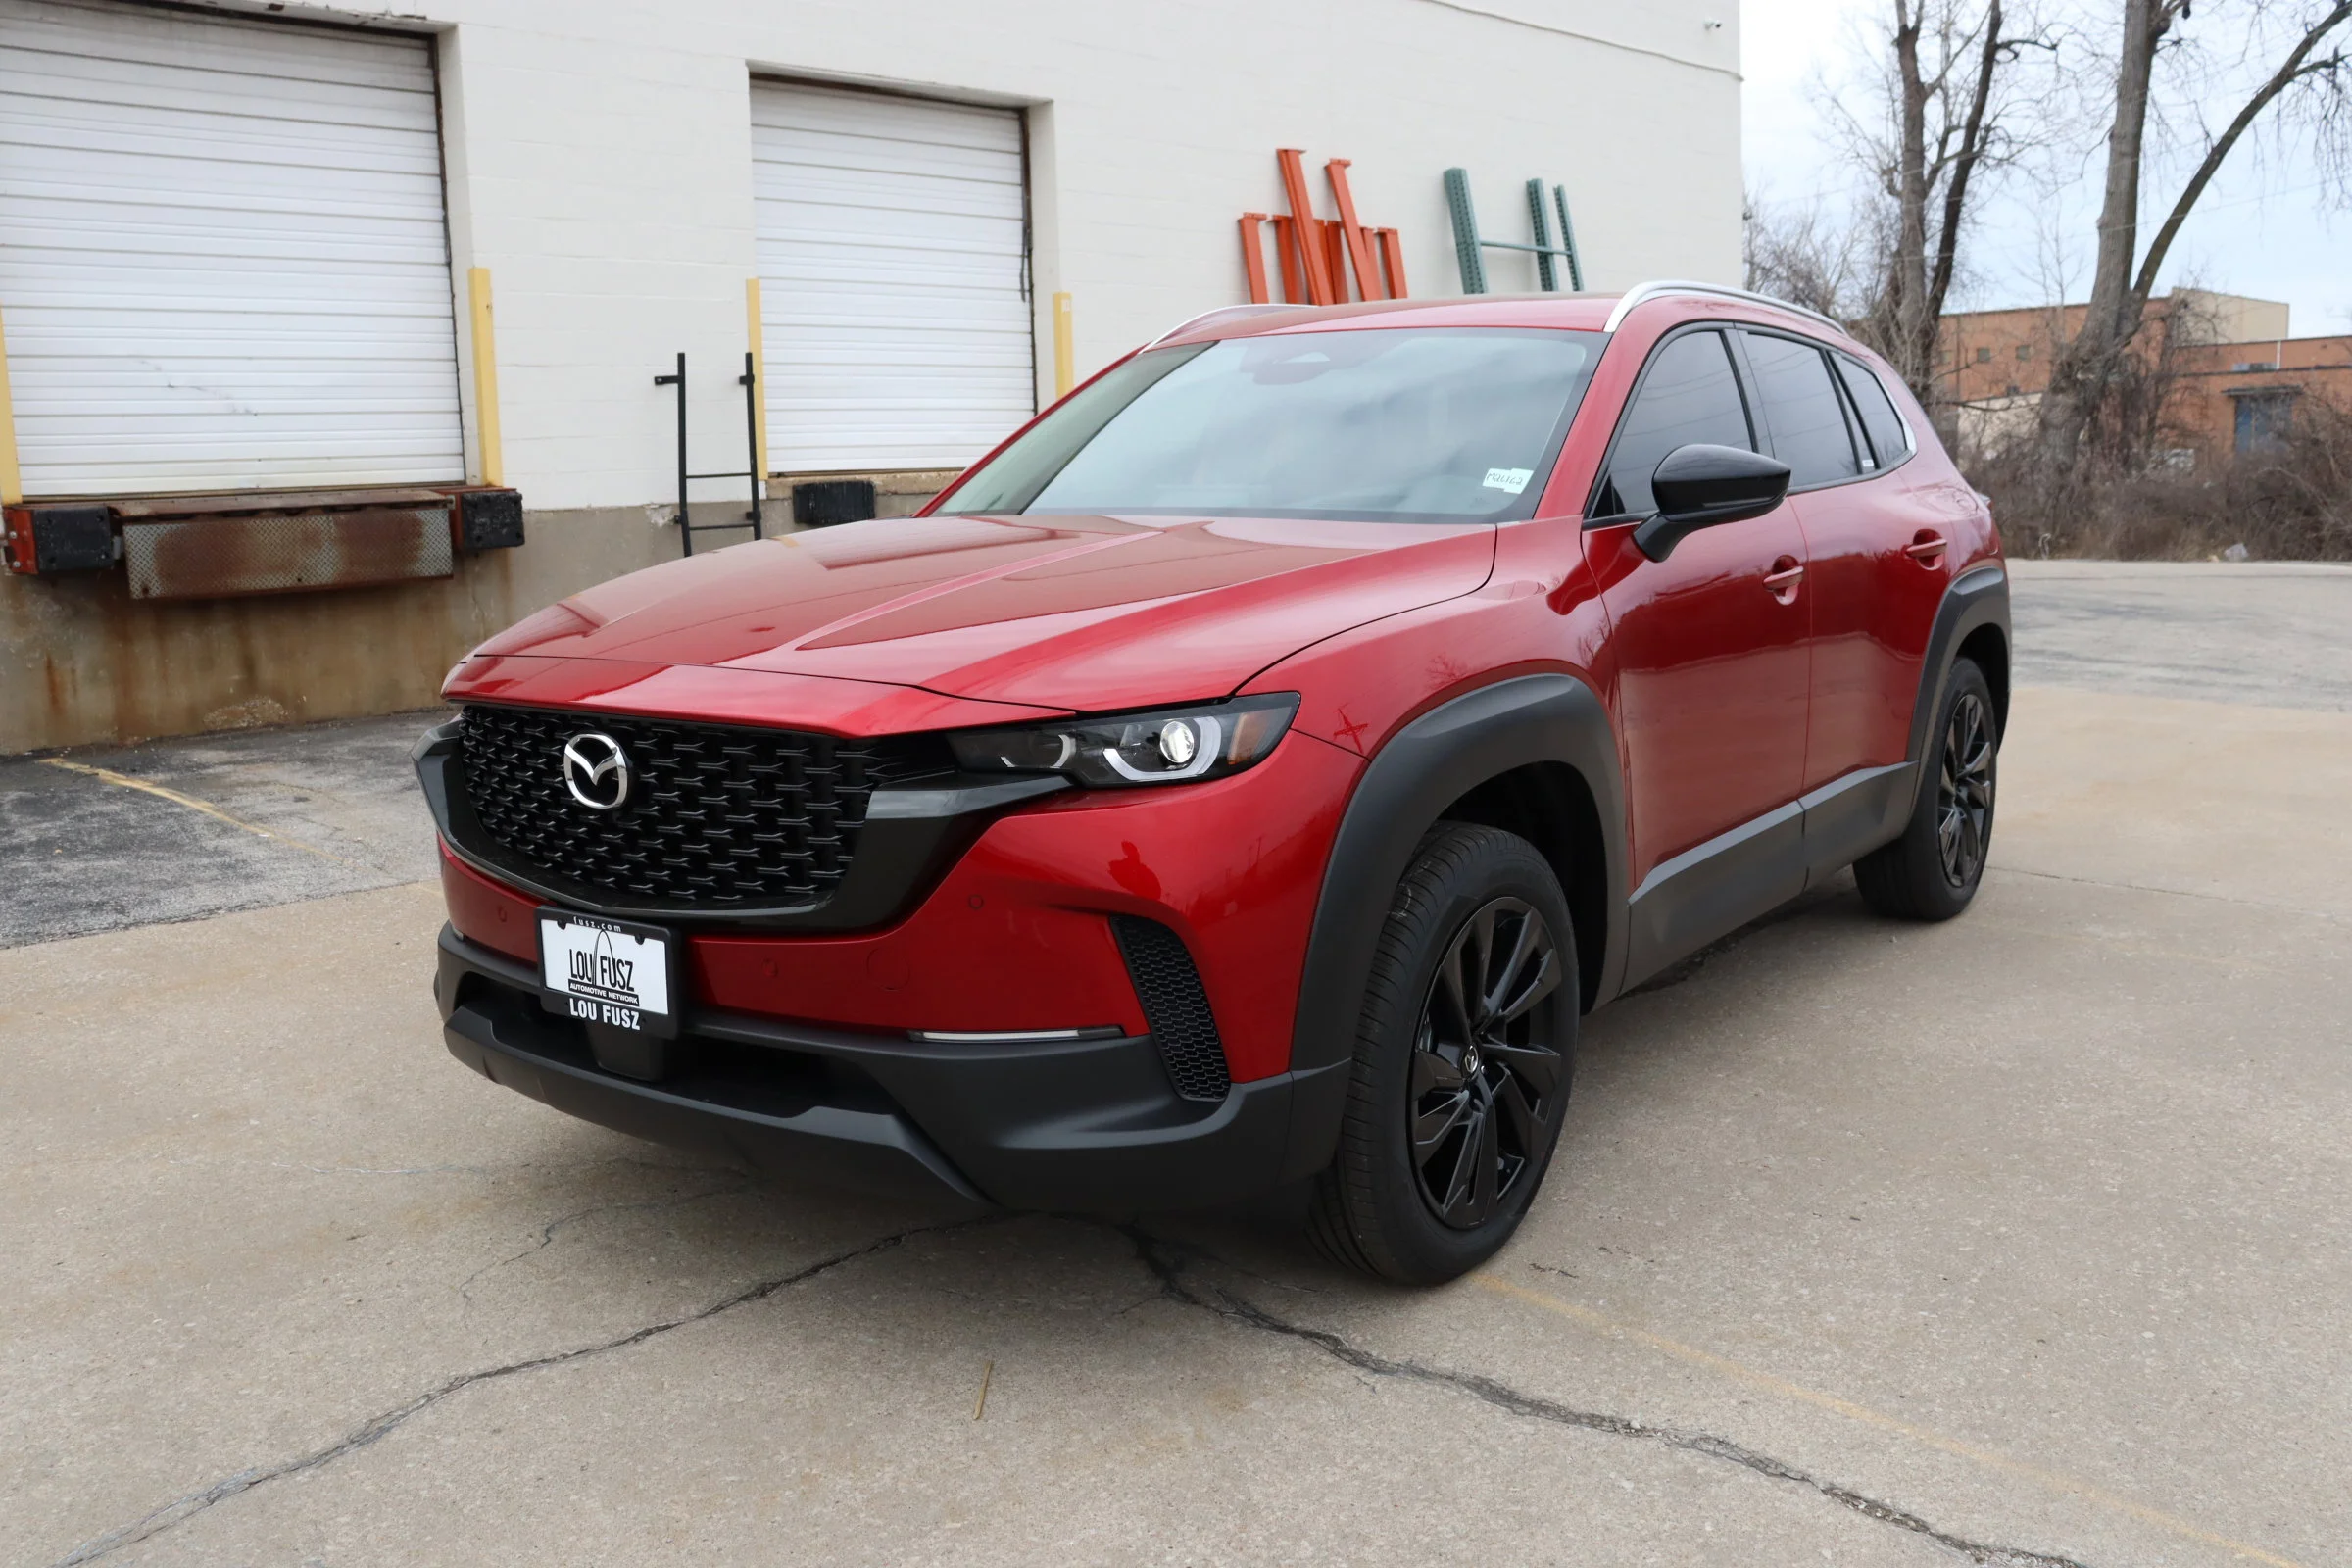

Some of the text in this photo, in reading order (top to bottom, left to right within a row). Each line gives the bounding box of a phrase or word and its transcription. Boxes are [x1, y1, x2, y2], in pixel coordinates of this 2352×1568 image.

[573, 916, 621, 932] fusz.com
[569, 949, 634, 991] LOU FUSZ
[569, 983, 638, 1004] AUTOMOTIVE NETWORK
[569, 998, 640, 1030] LOU FUSZ
